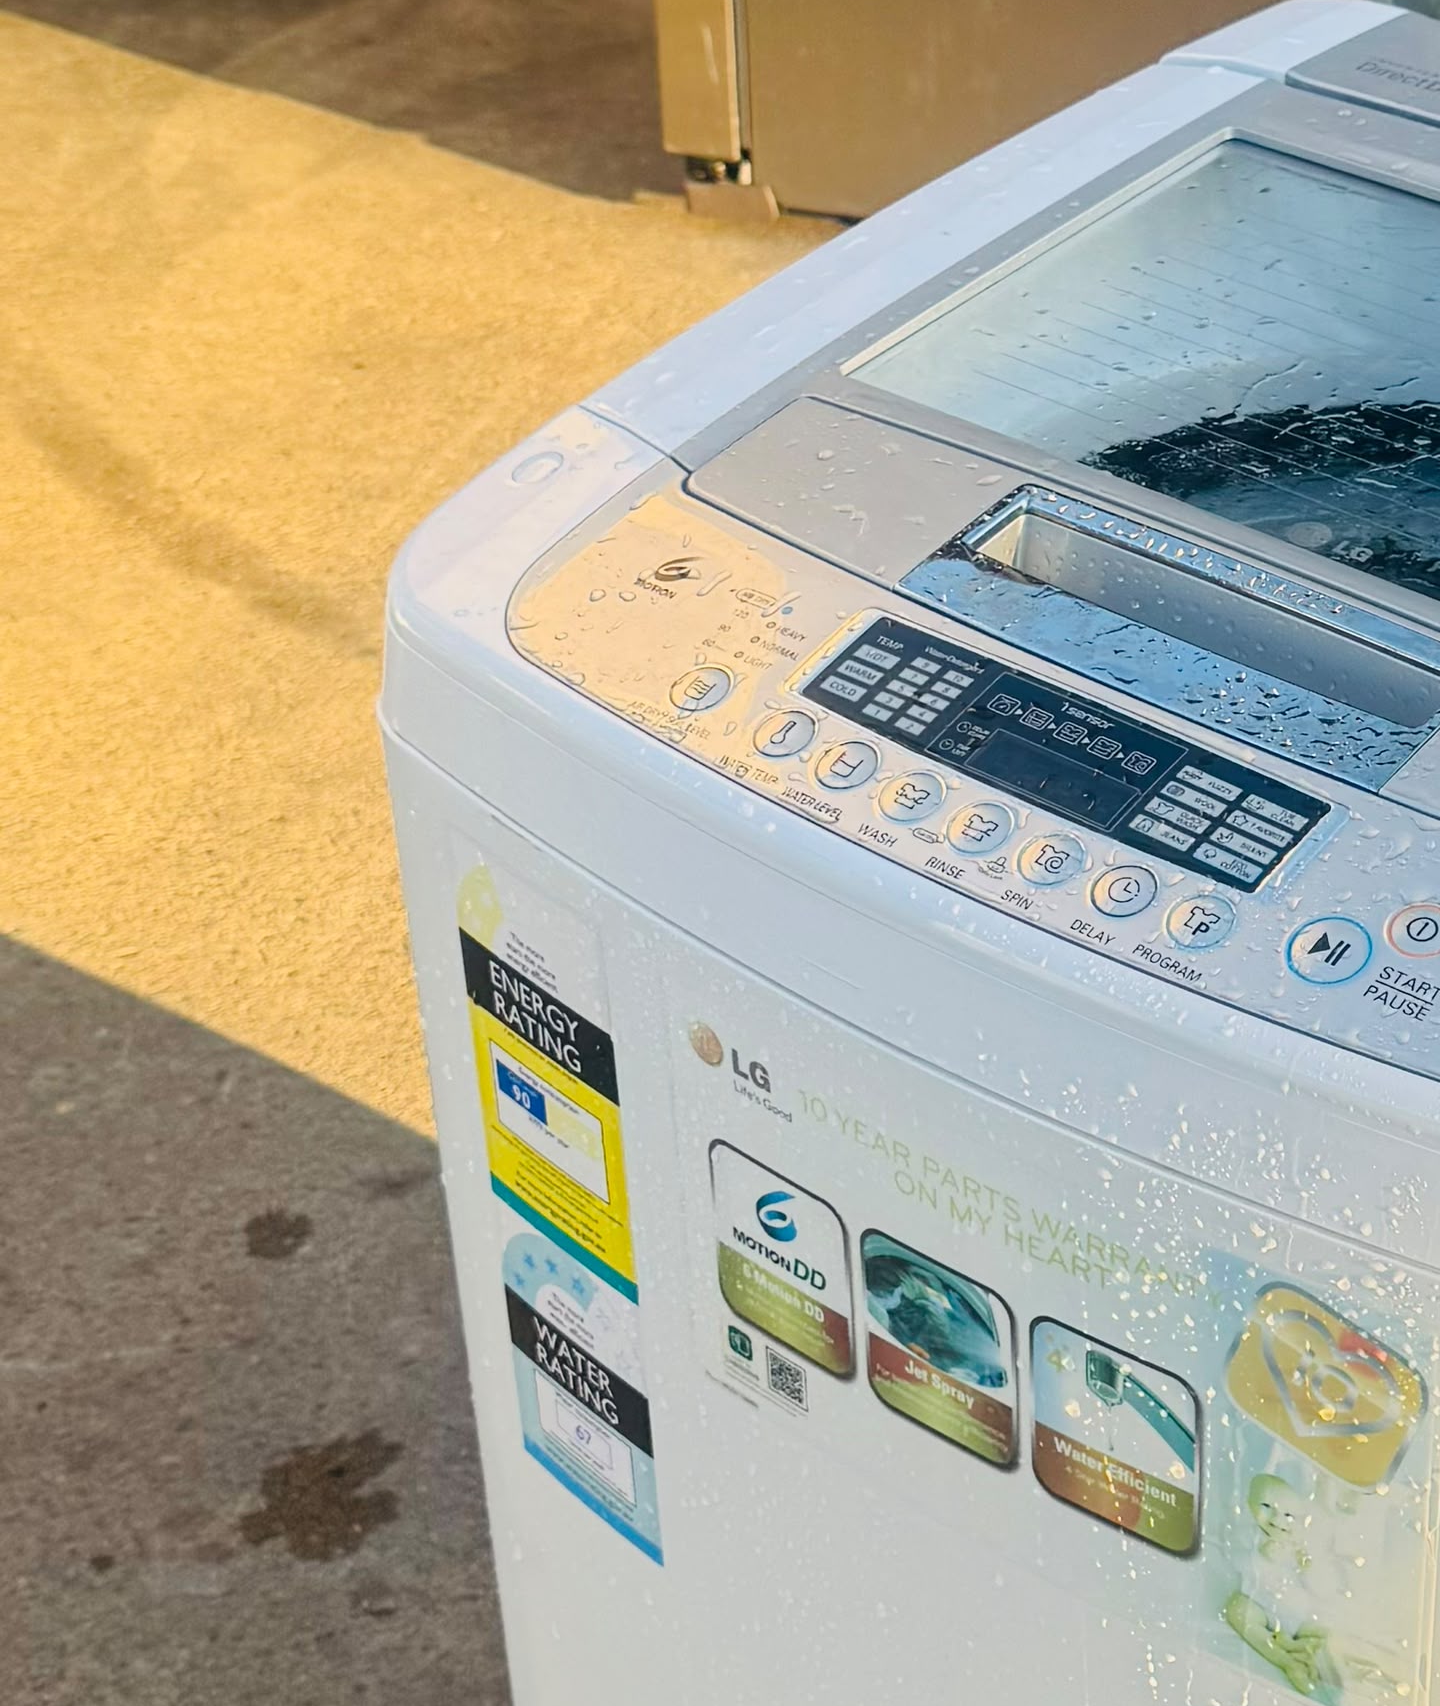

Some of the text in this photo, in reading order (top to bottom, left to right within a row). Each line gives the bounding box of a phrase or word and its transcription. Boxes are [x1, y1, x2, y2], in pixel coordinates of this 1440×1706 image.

[777, 626, 807, 643] HEAVY
[844, 664, 878, 681] WARM
[783, 785, 844, 822] WATER LEVEL
[857, 822, 898, 848] WASH
[925, 855, 966, 881] RINSE
[1000, 890, 1034, 911] SPIN
[1070, 918, 1117, 946] DELAY
[1133, 944, 1203, 983] PROGRAM
[489, 960, 578, 1042] ENERGY
[1363, 984, 1431, 1022] PAUSE
[493, 990, 581, 1073] RATING
[731, 1048, 771, 1093] LG
[512, 1084, 531, 1110] 90
[733, 1079, 792, 1123] Life's Good
[799, 1089, 828, 1122] 10
[834, 1108, 911, 1167] YEAR
[923, 1156, 1021, 1224] PARTS
[894, 1171, 1114, 1290] ON MY HEART
[804, 1297, 825, 1323] DD
[534, 1316, 614, 1398] WATER
[536, 1342, 619, 1425] RATING
[904, 1359, 975, 1410] Jet Spray
[1054, 1436, 1103, 1473] Water
[1106, 1460, 1177, 1507] Efficient
